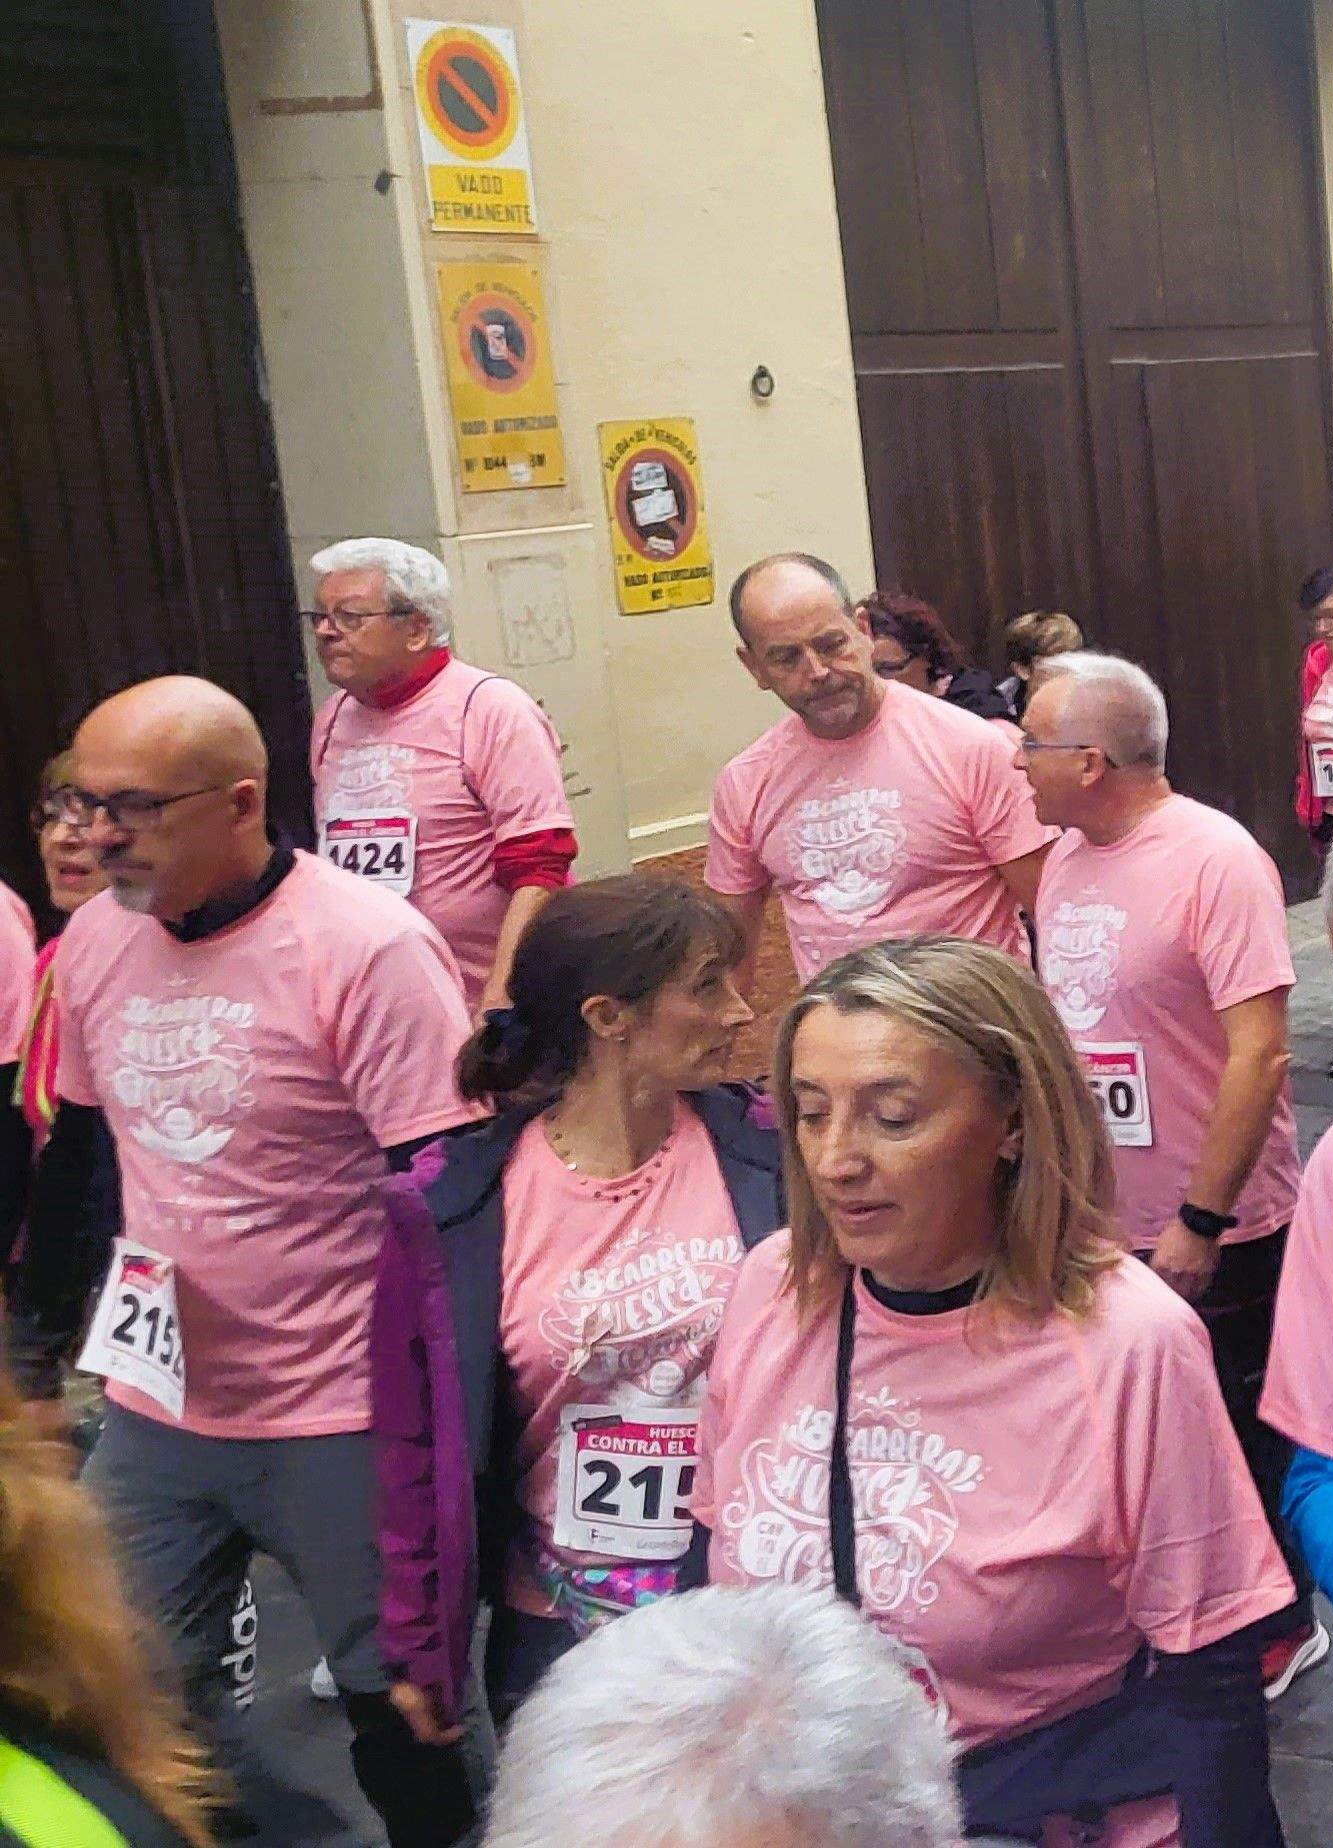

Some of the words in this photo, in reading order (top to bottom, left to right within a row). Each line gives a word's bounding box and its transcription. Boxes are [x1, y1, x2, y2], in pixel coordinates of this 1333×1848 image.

[456, 174, 503, 195] VADO
[433, 200, 531, 224] PERMANENTE
[328, 842, 405, 876] 1424
[587, 1433, 662, 1456] CONTRA
[668, 1440, 688, 1455] EL
[849, 1425, 963, 1480] ARRERA
